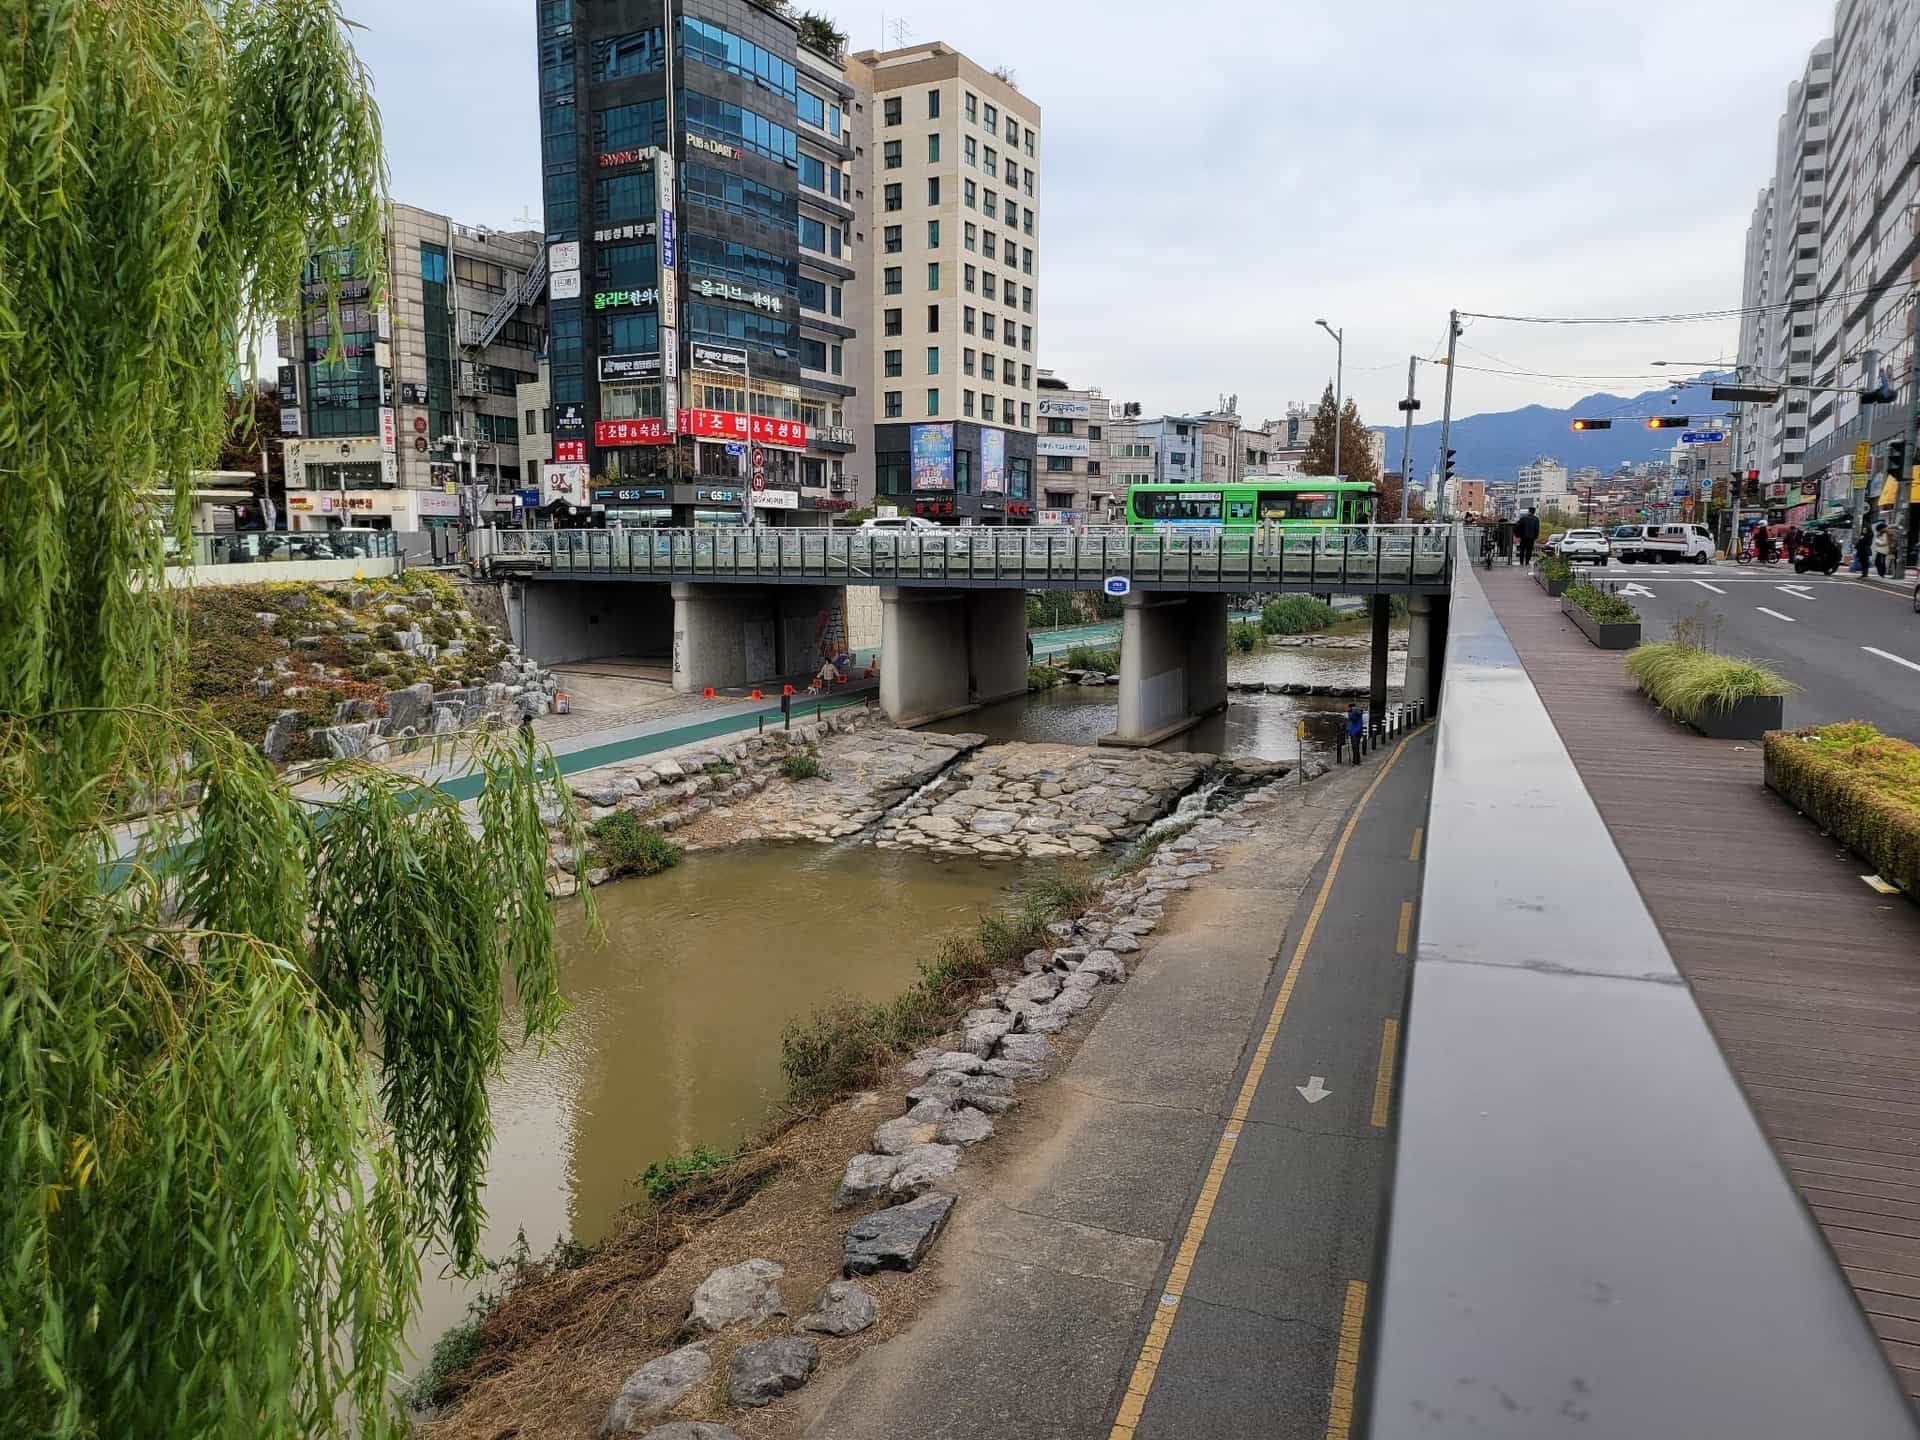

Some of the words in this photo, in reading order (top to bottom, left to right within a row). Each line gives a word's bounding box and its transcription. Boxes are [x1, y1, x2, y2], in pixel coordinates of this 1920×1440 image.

[701, 279, 742, 299] 올리브
[594, 291, 629, 309] 올리브
[753, 421, 761, 433] &
[619, 489, 640, 499] GS25
[711, 490, 733, 501] GS25
